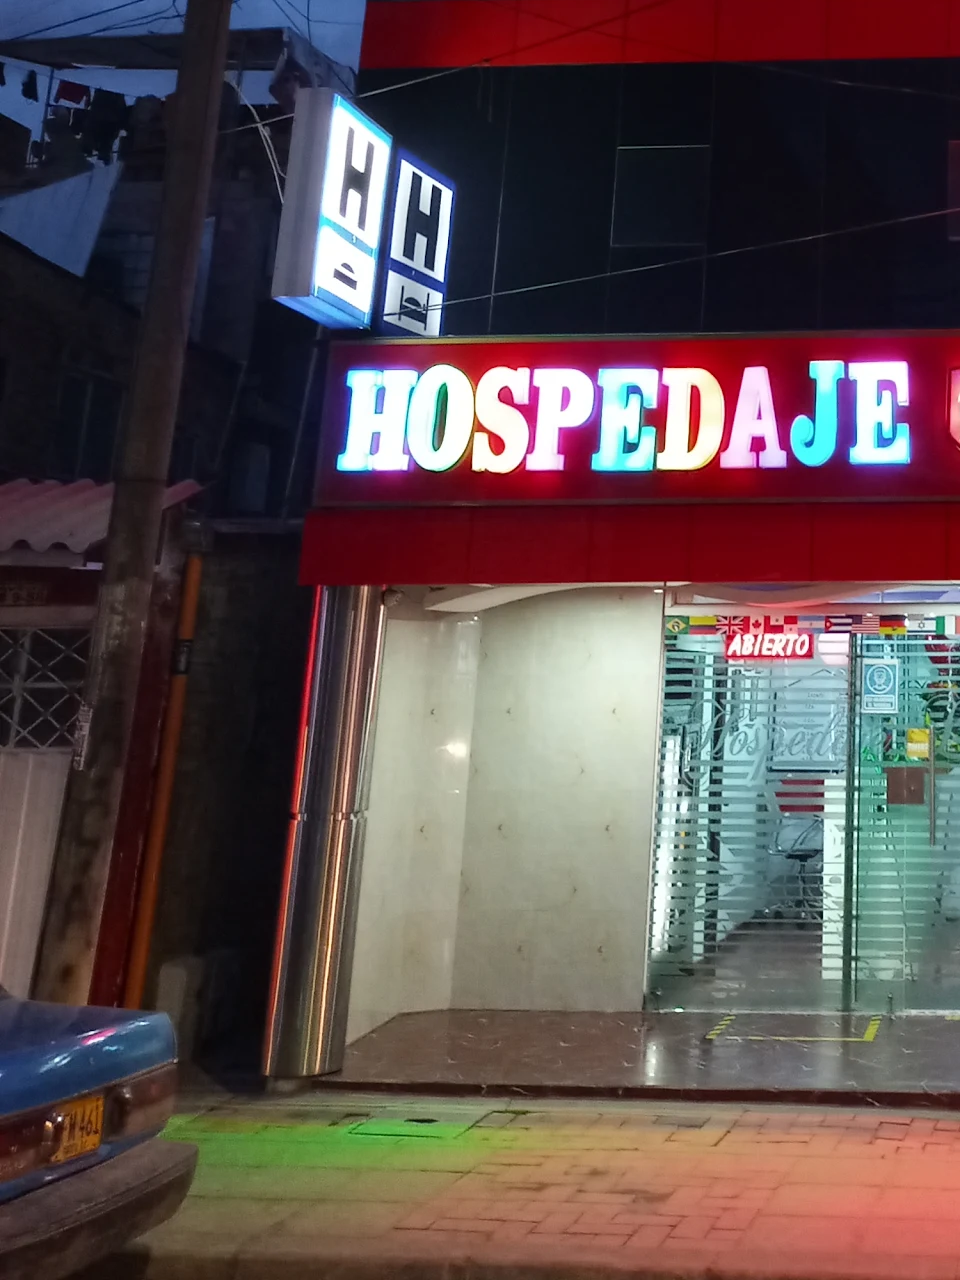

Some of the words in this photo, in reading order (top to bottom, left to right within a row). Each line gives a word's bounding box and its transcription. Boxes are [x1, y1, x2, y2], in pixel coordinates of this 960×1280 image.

[339, 125, 375, 231] H
[336, 360, 911, 473] HOSPEDAJE
[727, 633, 809, 657] ABIERTO
